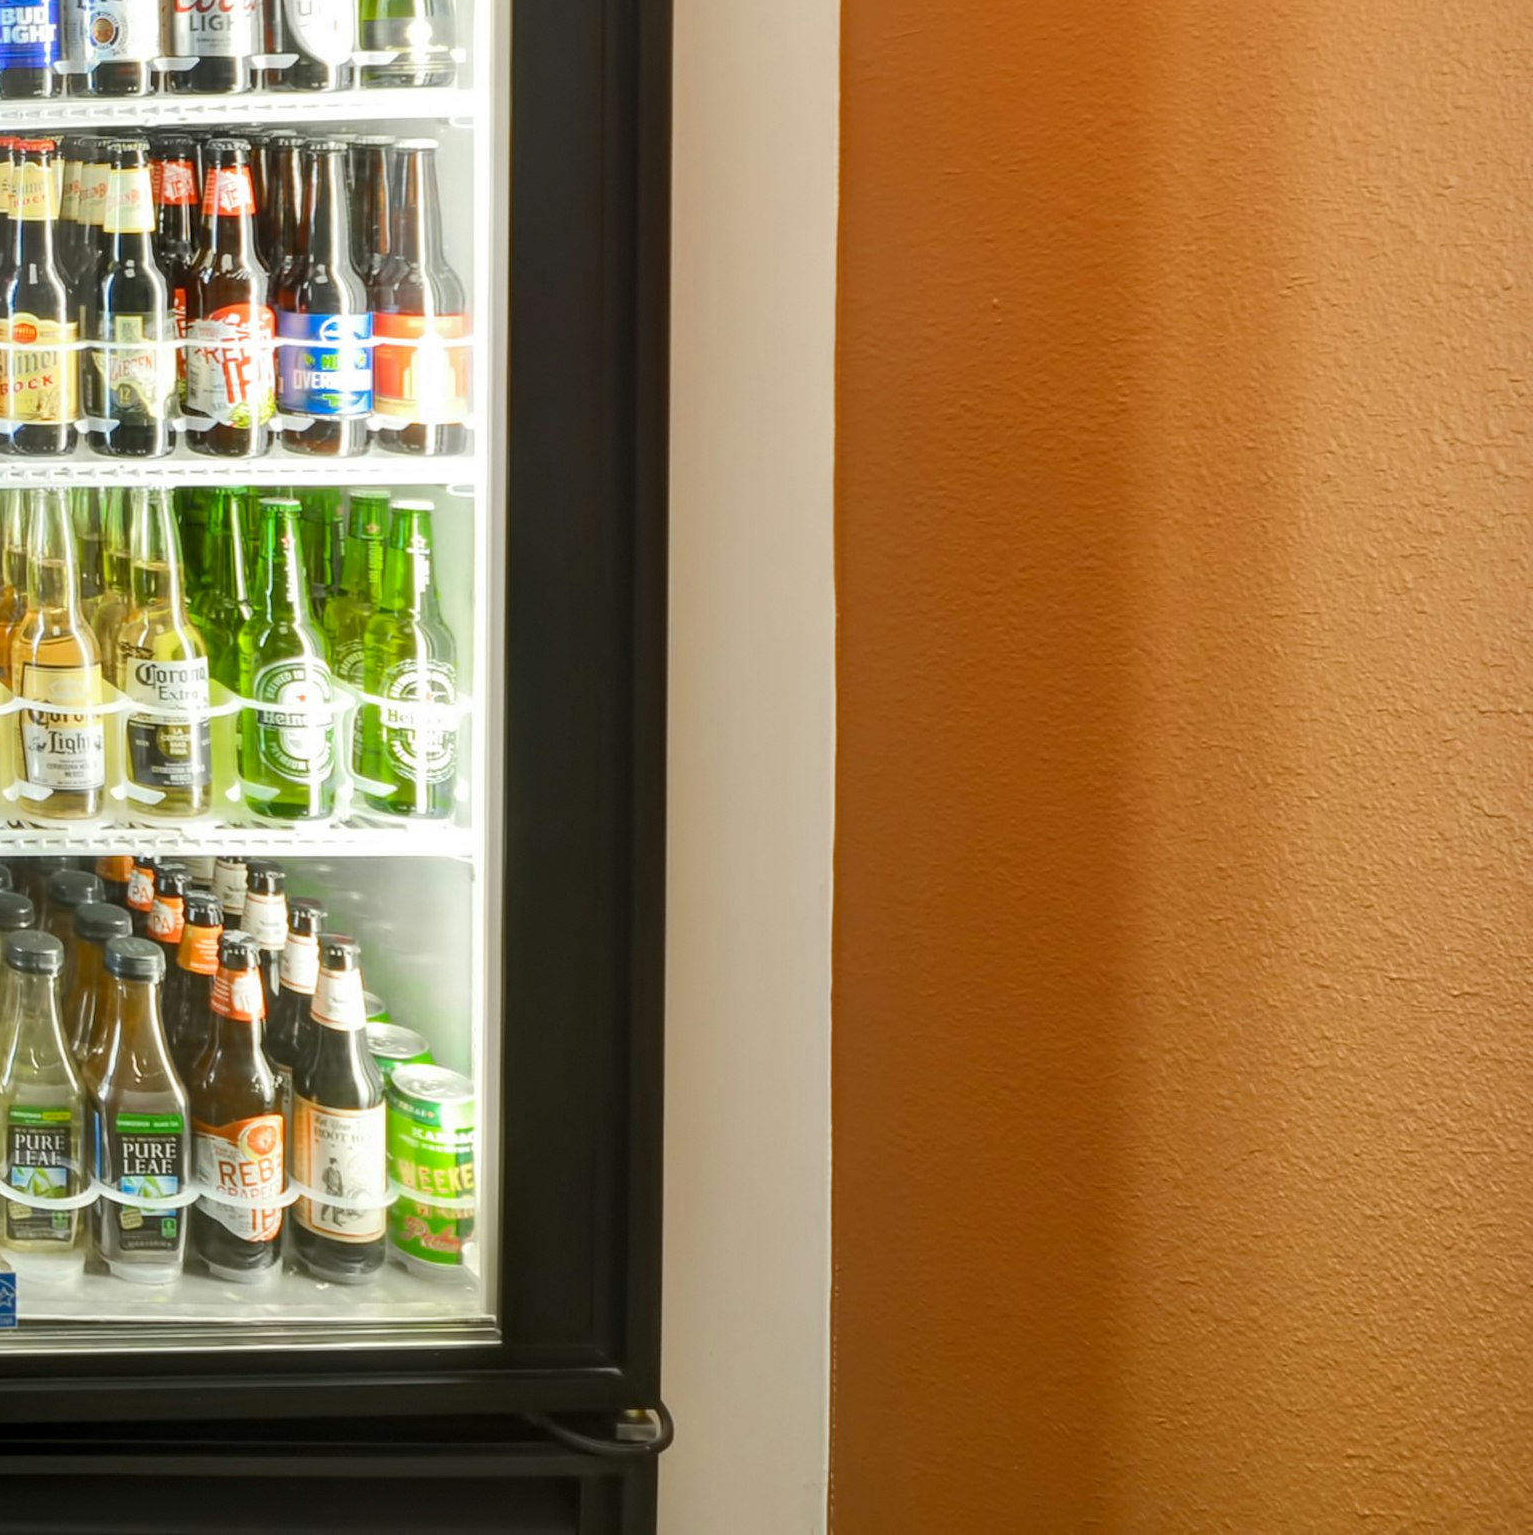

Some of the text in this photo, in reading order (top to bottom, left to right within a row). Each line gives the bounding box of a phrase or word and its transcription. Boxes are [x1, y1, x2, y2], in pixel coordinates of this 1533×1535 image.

[0, 374, 55, 396] BOCK
[135, 661, 206, 690] Corona
[158, 685, 199, 701] Extra
[48, 730, 87, 755] Ligh
[14, 1133, 65, 1151] PURE
[122, 1142, 177, 1159] PURE
[14, 1150, 62, 1166] LEAF
[123, 1159, 174, 1175] LEAF
